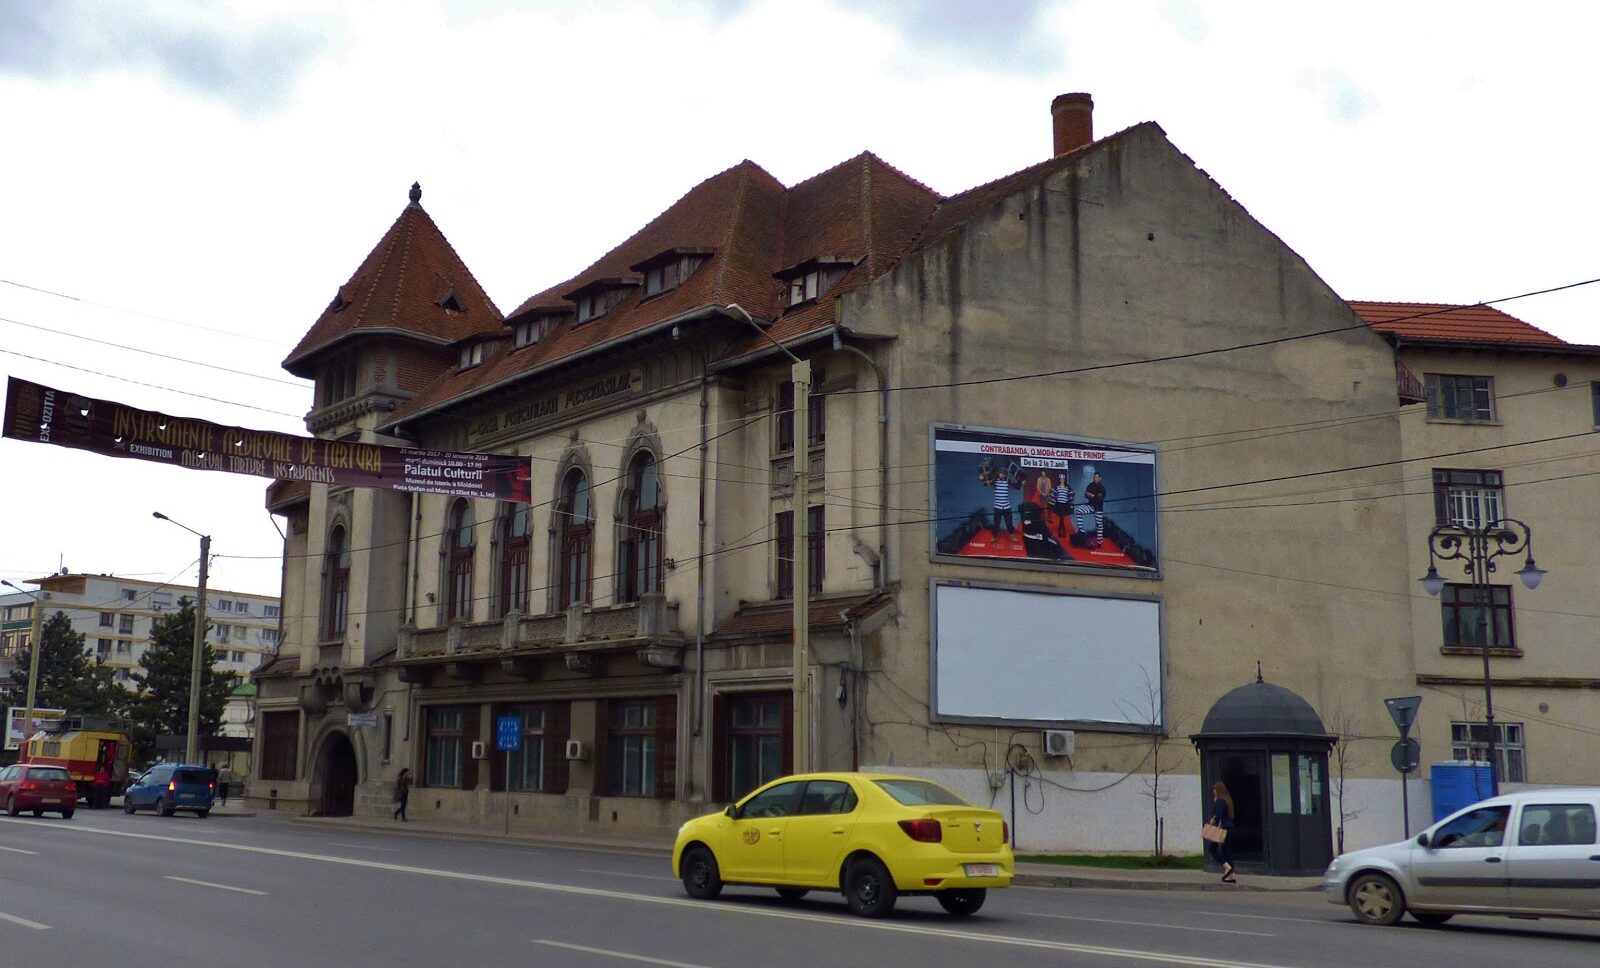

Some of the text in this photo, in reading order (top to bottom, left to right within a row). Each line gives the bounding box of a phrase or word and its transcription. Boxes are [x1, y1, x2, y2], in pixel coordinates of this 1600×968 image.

[112, 407, 214, 452] INSTRUMENTE
[222, 430, 292, 462] MEDIEVALE
[302, 440, 315, 464] DE
[980, 444, 1029, 456] CONTRABANDA,
[1030, 447, 1036, 456] O
[1056, 449, 1073, 458] CARE
[1074, 451, 1082, 459] TE
[1083, 451, 1106, 460] PRINDE
[129, 443, 336, 483] EXHIBITION MEDIEVAL TORTURE INSTRUMENTS
[1023, 458, 1031, 466] De
[1038, 459, 1043, 467] 2
[1043, 459, 1049, 467] la
[404, 464, 482, 480] Palatul Culturii
[457, 481, 483, 489] Moldovei
